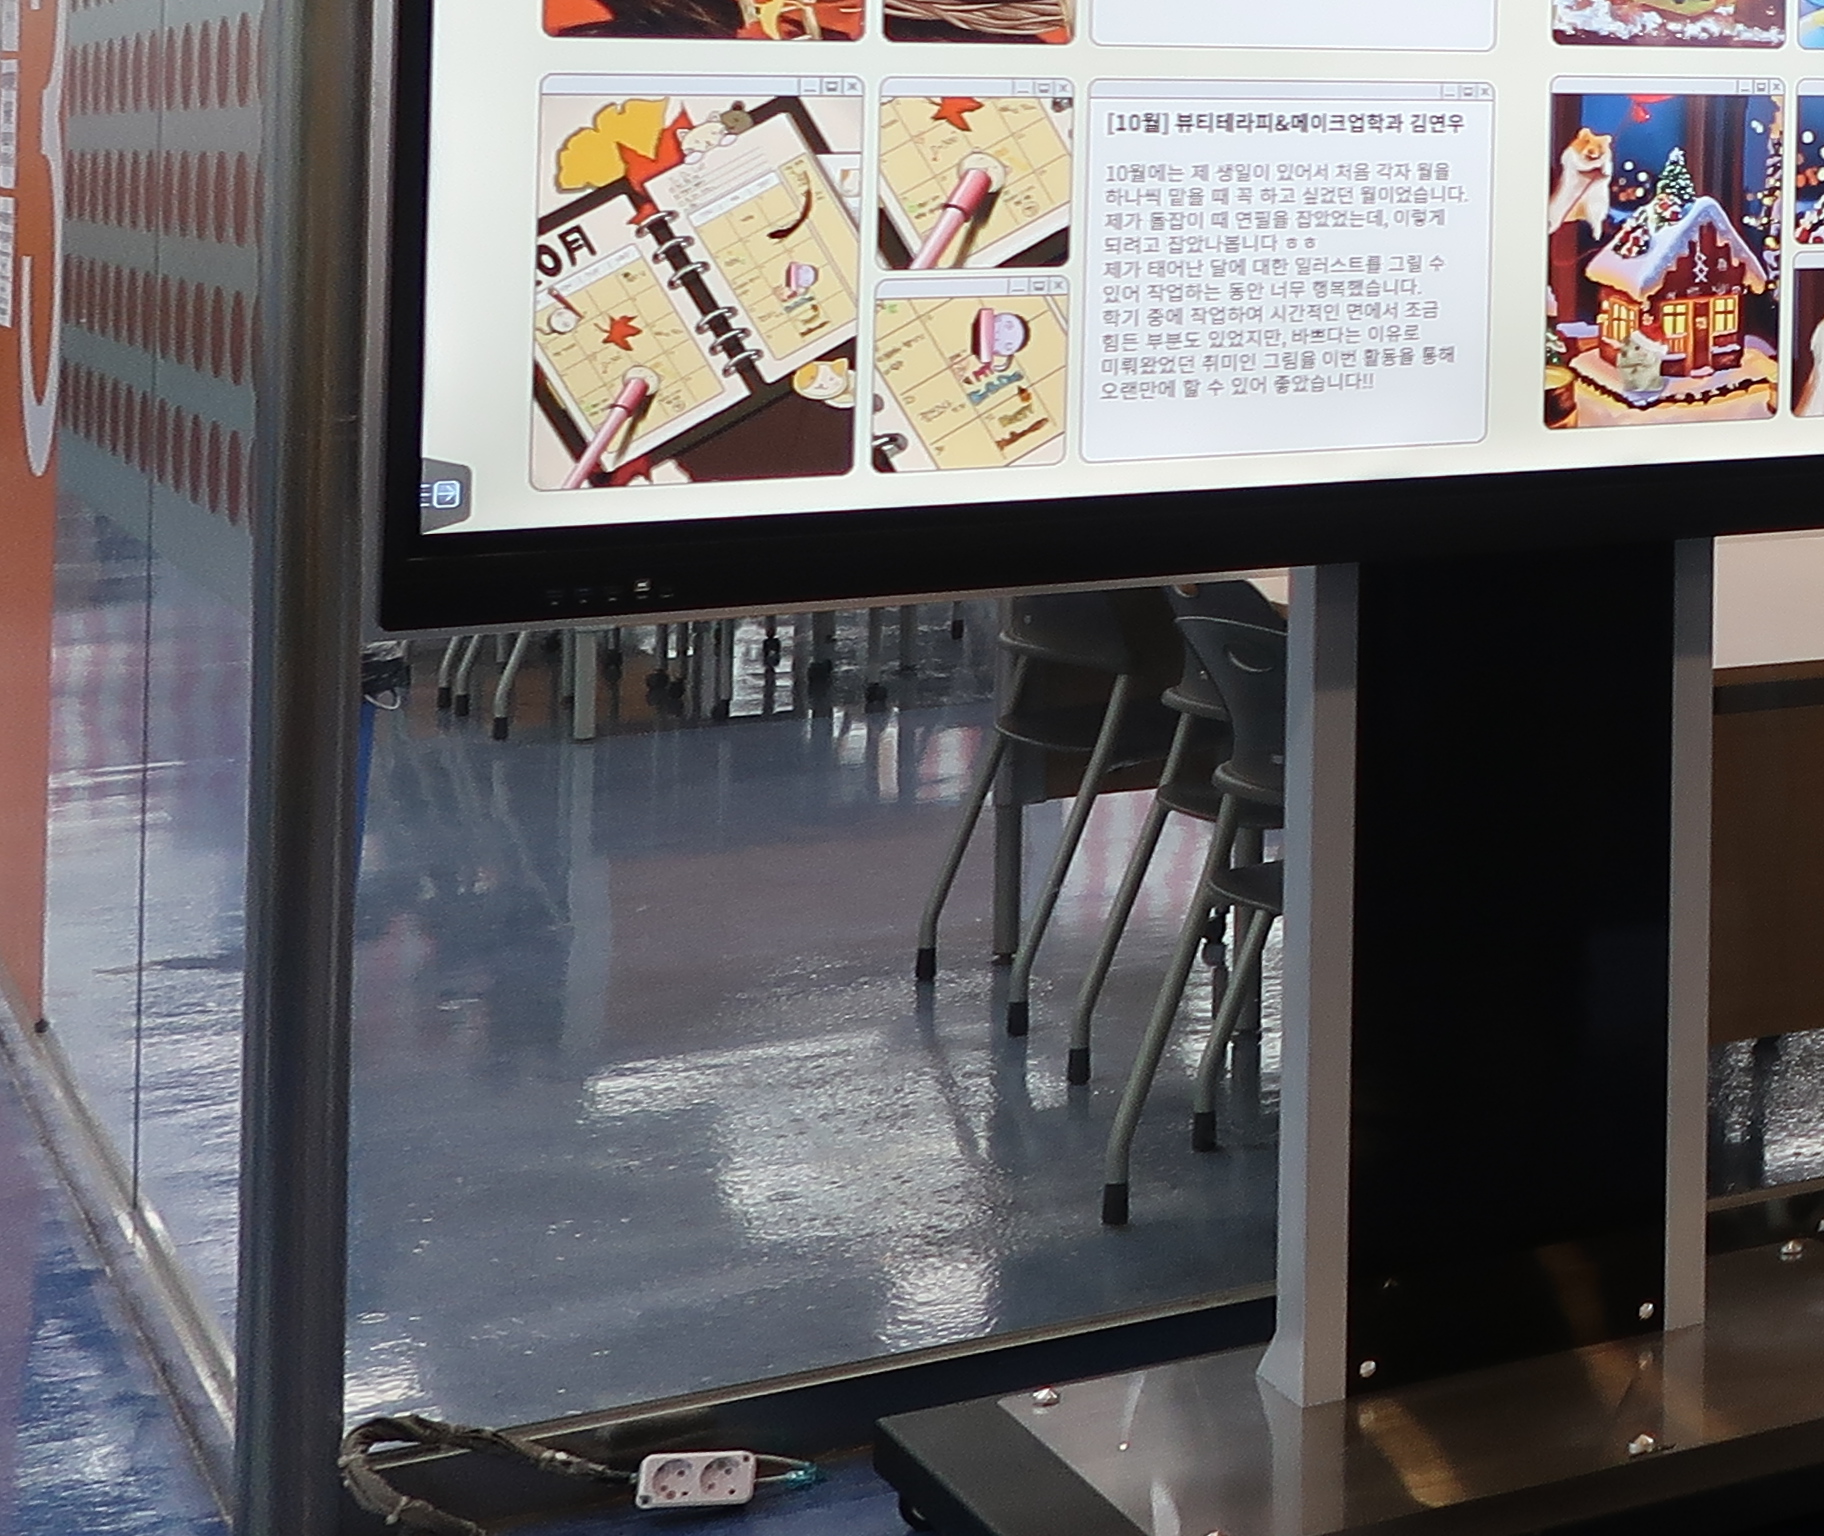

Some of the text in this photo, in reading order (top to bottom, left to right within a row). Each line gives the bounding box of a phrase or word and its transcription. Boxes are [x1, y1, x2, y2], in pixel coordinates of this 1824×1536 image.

[1106, 111, 1465, 135] [10월] 뷰티테라피&메이크업학과 김연우
